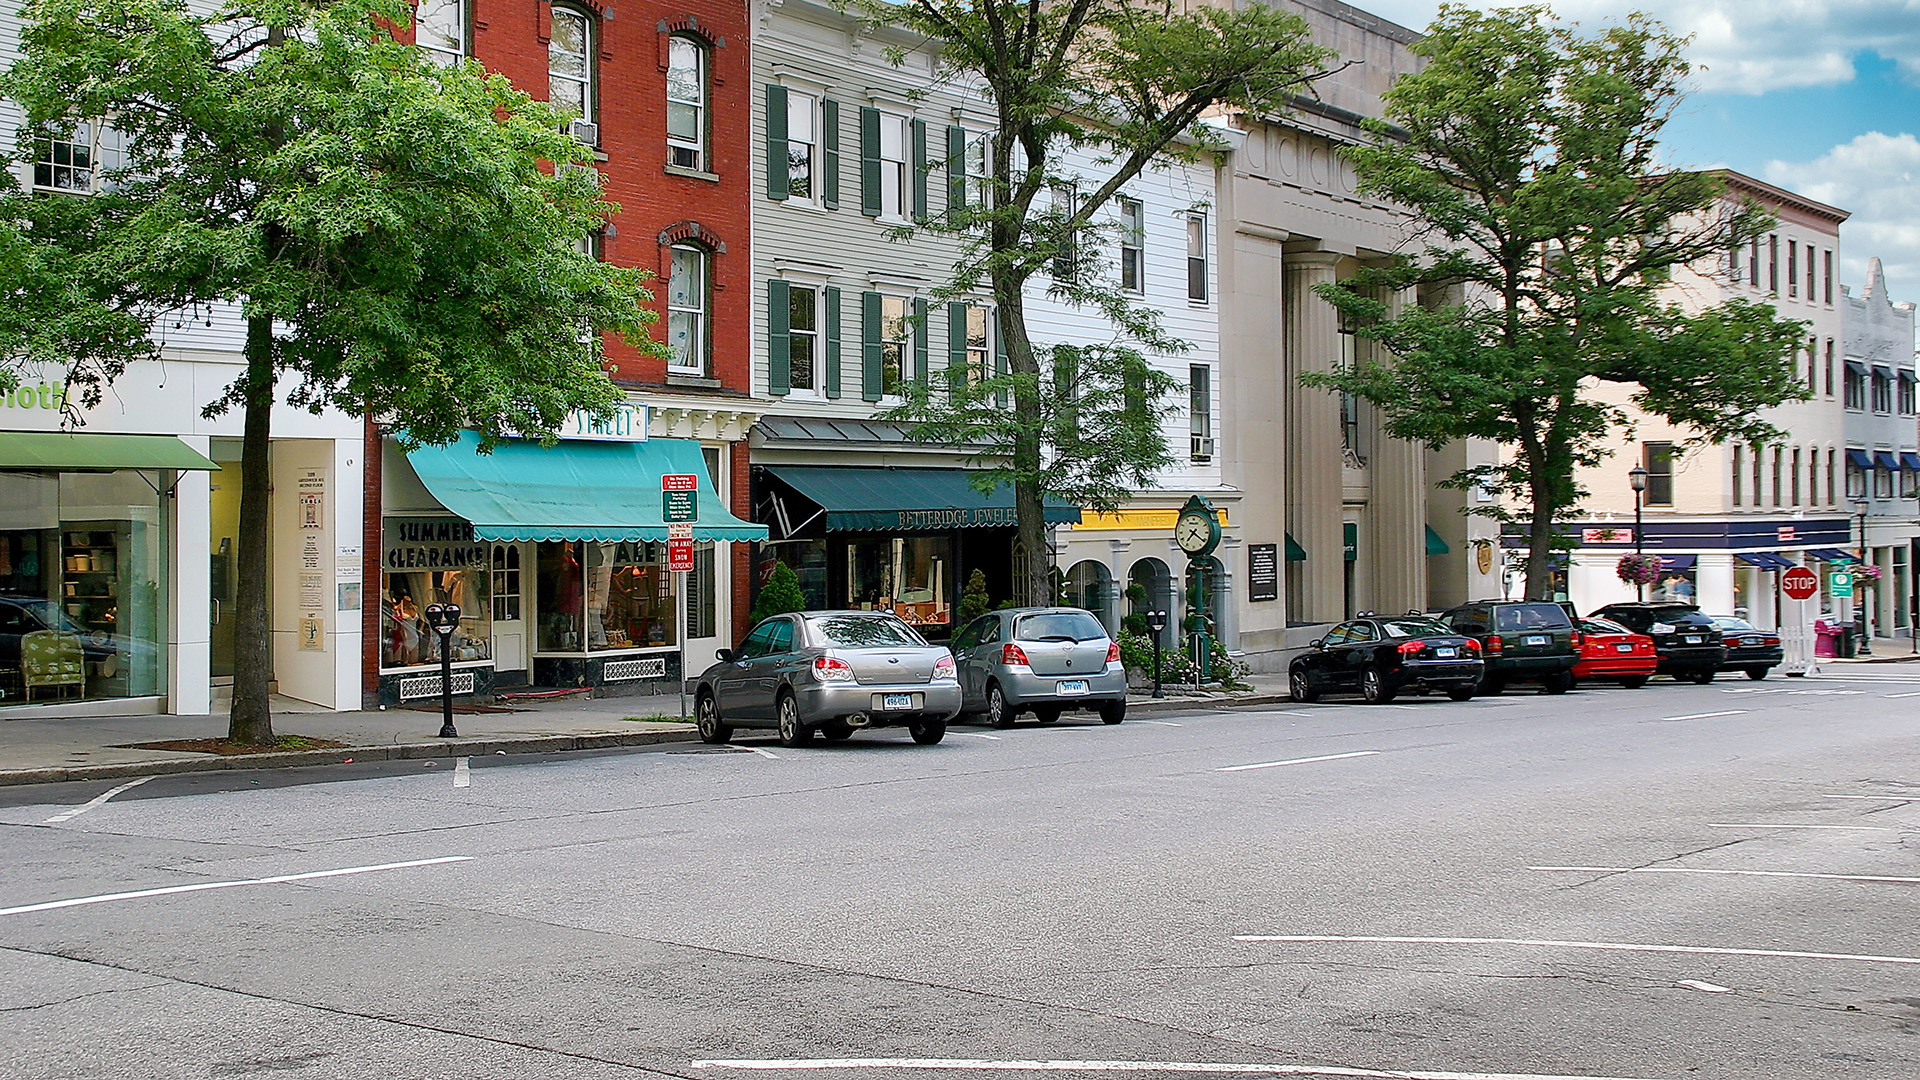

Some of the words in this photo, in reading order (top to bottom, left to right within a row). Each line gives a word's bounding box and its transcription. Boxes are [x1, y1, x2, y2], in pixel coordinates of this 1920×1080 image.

[0, 381, 70, 409] loth
[898, 510, 968, 525] BETTERIDGE
[973, 508, 1019, 523] JEWELER
[400, 522, 471, 542] SUMMER
[389, 547, 483, 568] CLEARANCE
[616, 541, 656, 562] ALE
[670, 562, 694, 570] EMERGENCY
[1784, 577, 1816, 590] STOP
